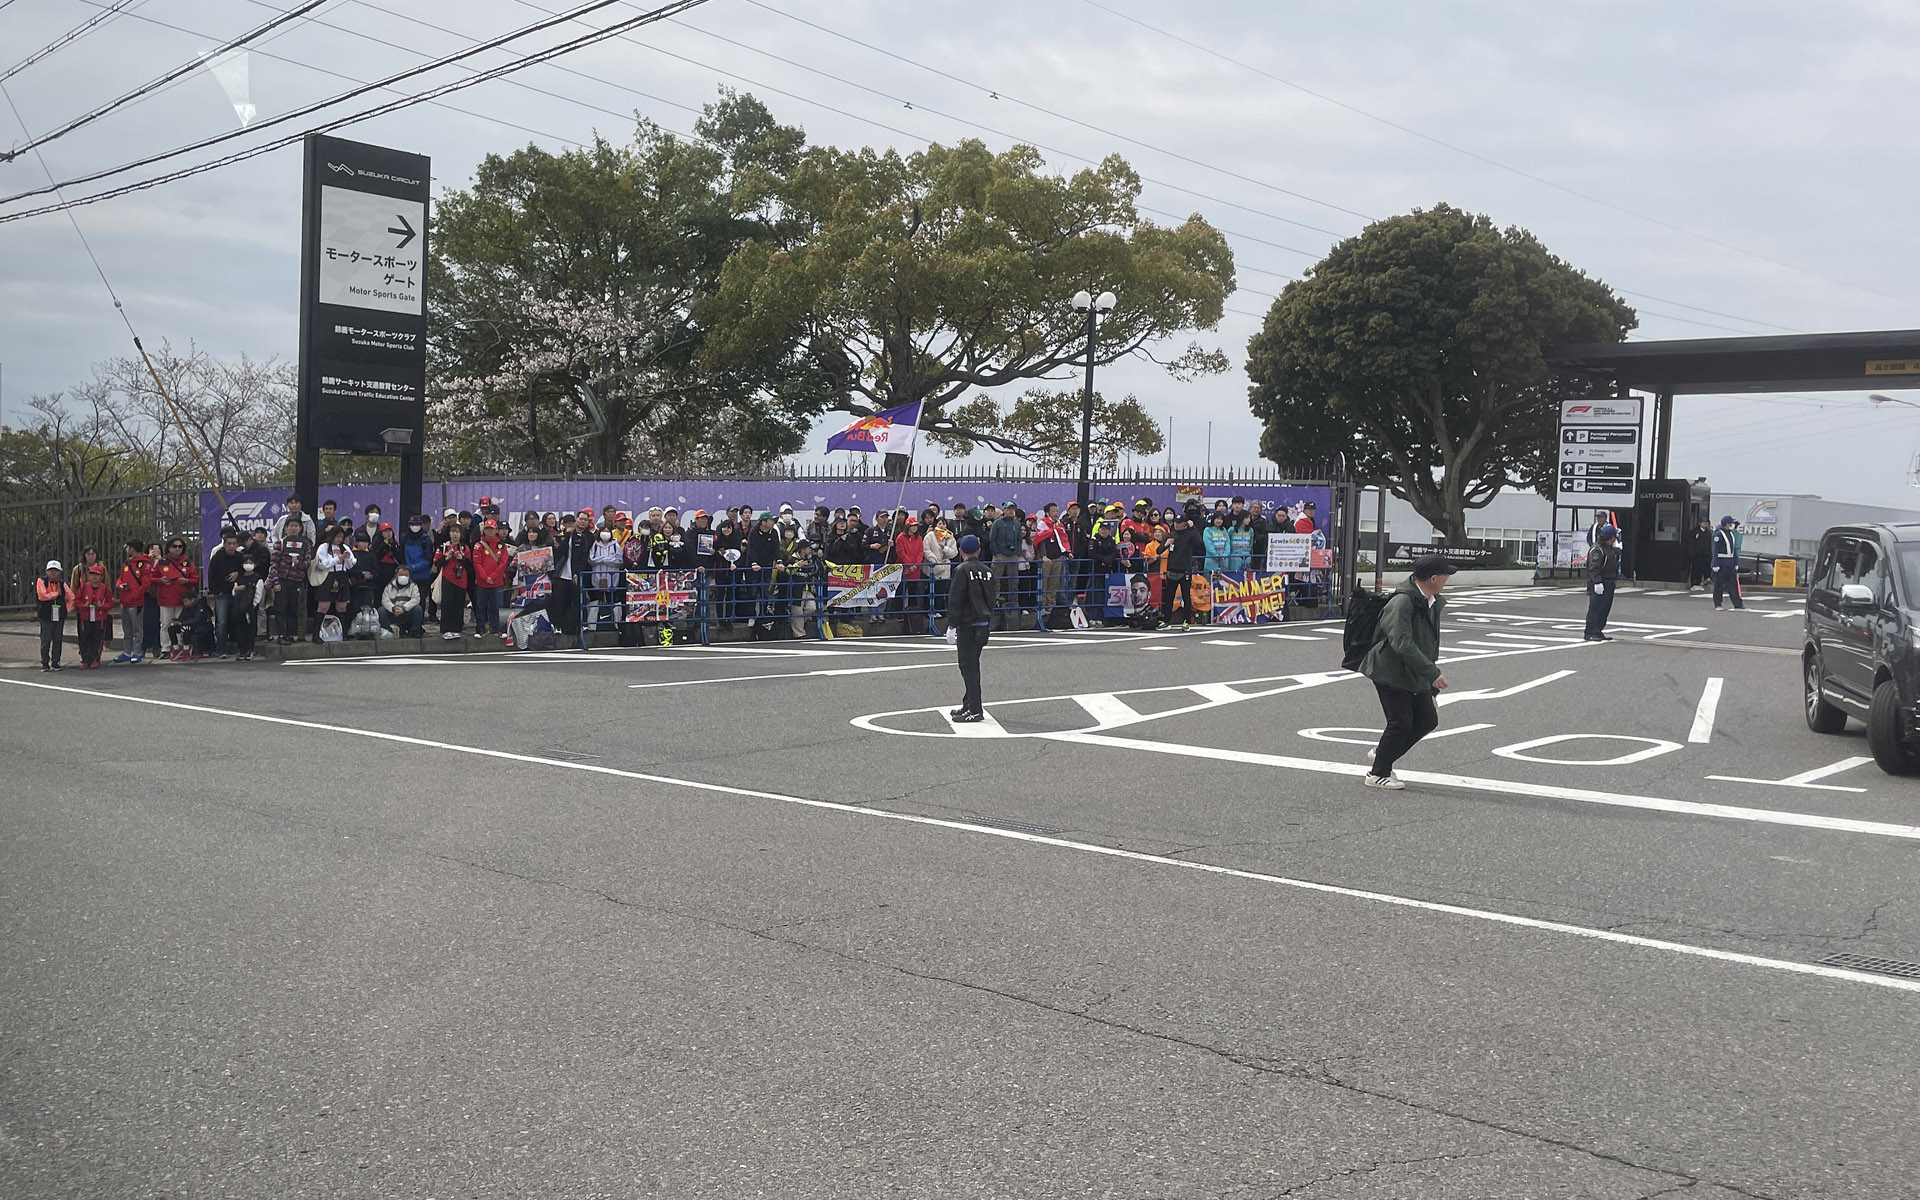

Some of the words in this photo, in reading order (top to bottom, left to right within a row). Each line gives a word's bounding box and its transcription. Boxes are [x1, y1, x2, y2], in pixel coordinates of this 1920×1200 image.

[357, 169, 390, 180] SUZUKA
[391, 175, 420, 186] CIRCUIT
[326, 247, 417, 271] モータースポーツ
[384, 273, 415, 288] ゲート
[350, 286, 371, 296] Motor
[373, 289, 397, 300] Sports
[399, 292, 416, 302] Gate
[352, 338, 370, 346] Suzuka
[386, 342, 402, 350] Sports
[322, 387, 340, 395] Suzuka
[341, 389, 358, 397] Circuit
[358, 391, 374, 399] Traffic
[375, 392, 399, 400] Education
[399, 394, 416, 402] Center
[222, 501, 268, 519] F1
[1737, 524, 1777, 536] ENTER
[1108, 586, 1129, 606] 31
[1214, 575, 1283, 603] HAMMER
[1241, 593, 1284, 618] TIME!
